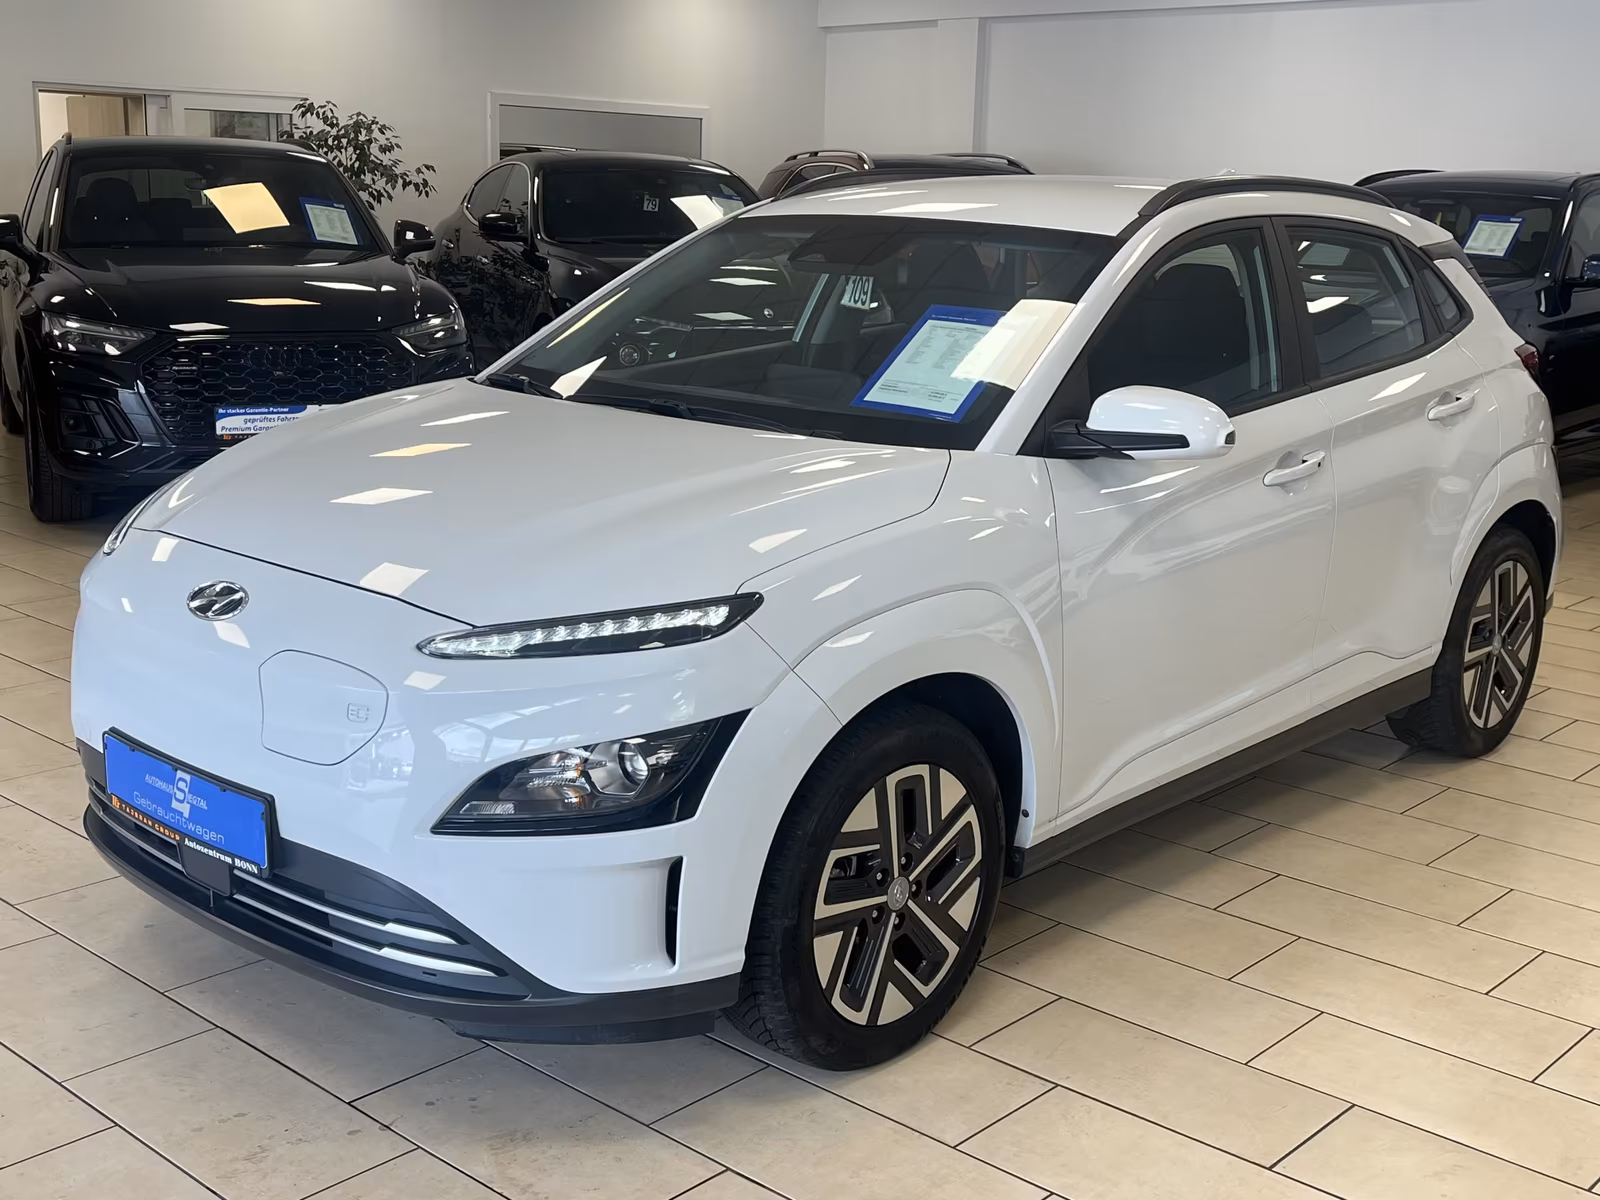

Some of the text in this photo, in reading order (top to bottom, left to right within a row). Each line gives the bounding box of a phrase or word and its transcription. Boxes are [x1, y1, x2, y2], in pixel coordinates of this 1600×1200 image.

[646, 198, 657, 210] 79
[848, 276, 870, 306] 109
[243, 416, 276, 425] geprüftes
[145, 773, 174, 794] AUTOHAUS
[133, 791, 225, 844] Gebrauchtwagen
[154, 823, 180, 841] GROUP
[184, 837, 258, 874] Autozentrum BONN
